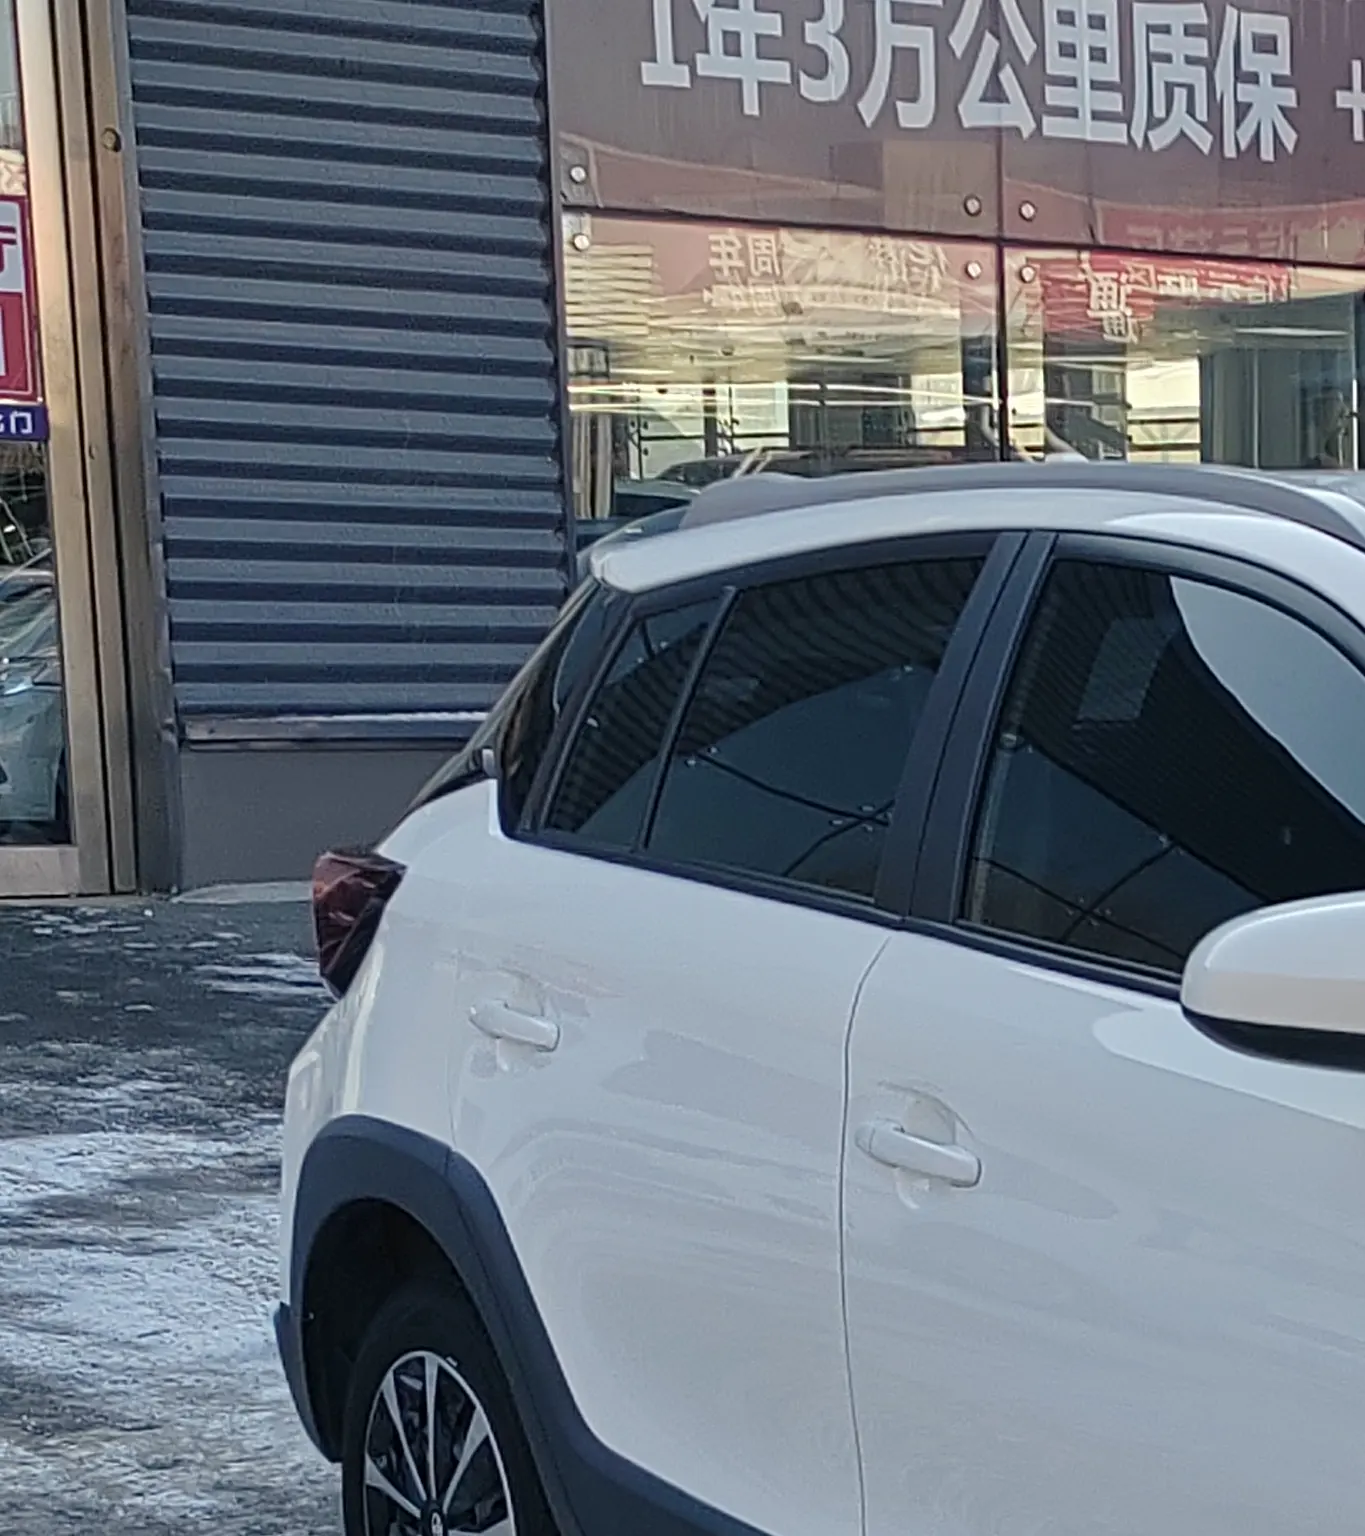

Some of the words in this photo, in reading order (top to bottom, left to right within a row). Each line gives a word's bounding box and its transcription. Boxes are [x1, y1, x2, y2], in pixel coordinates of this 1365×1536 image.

[640, 0, 1299, 162] 1年3万公里质保
